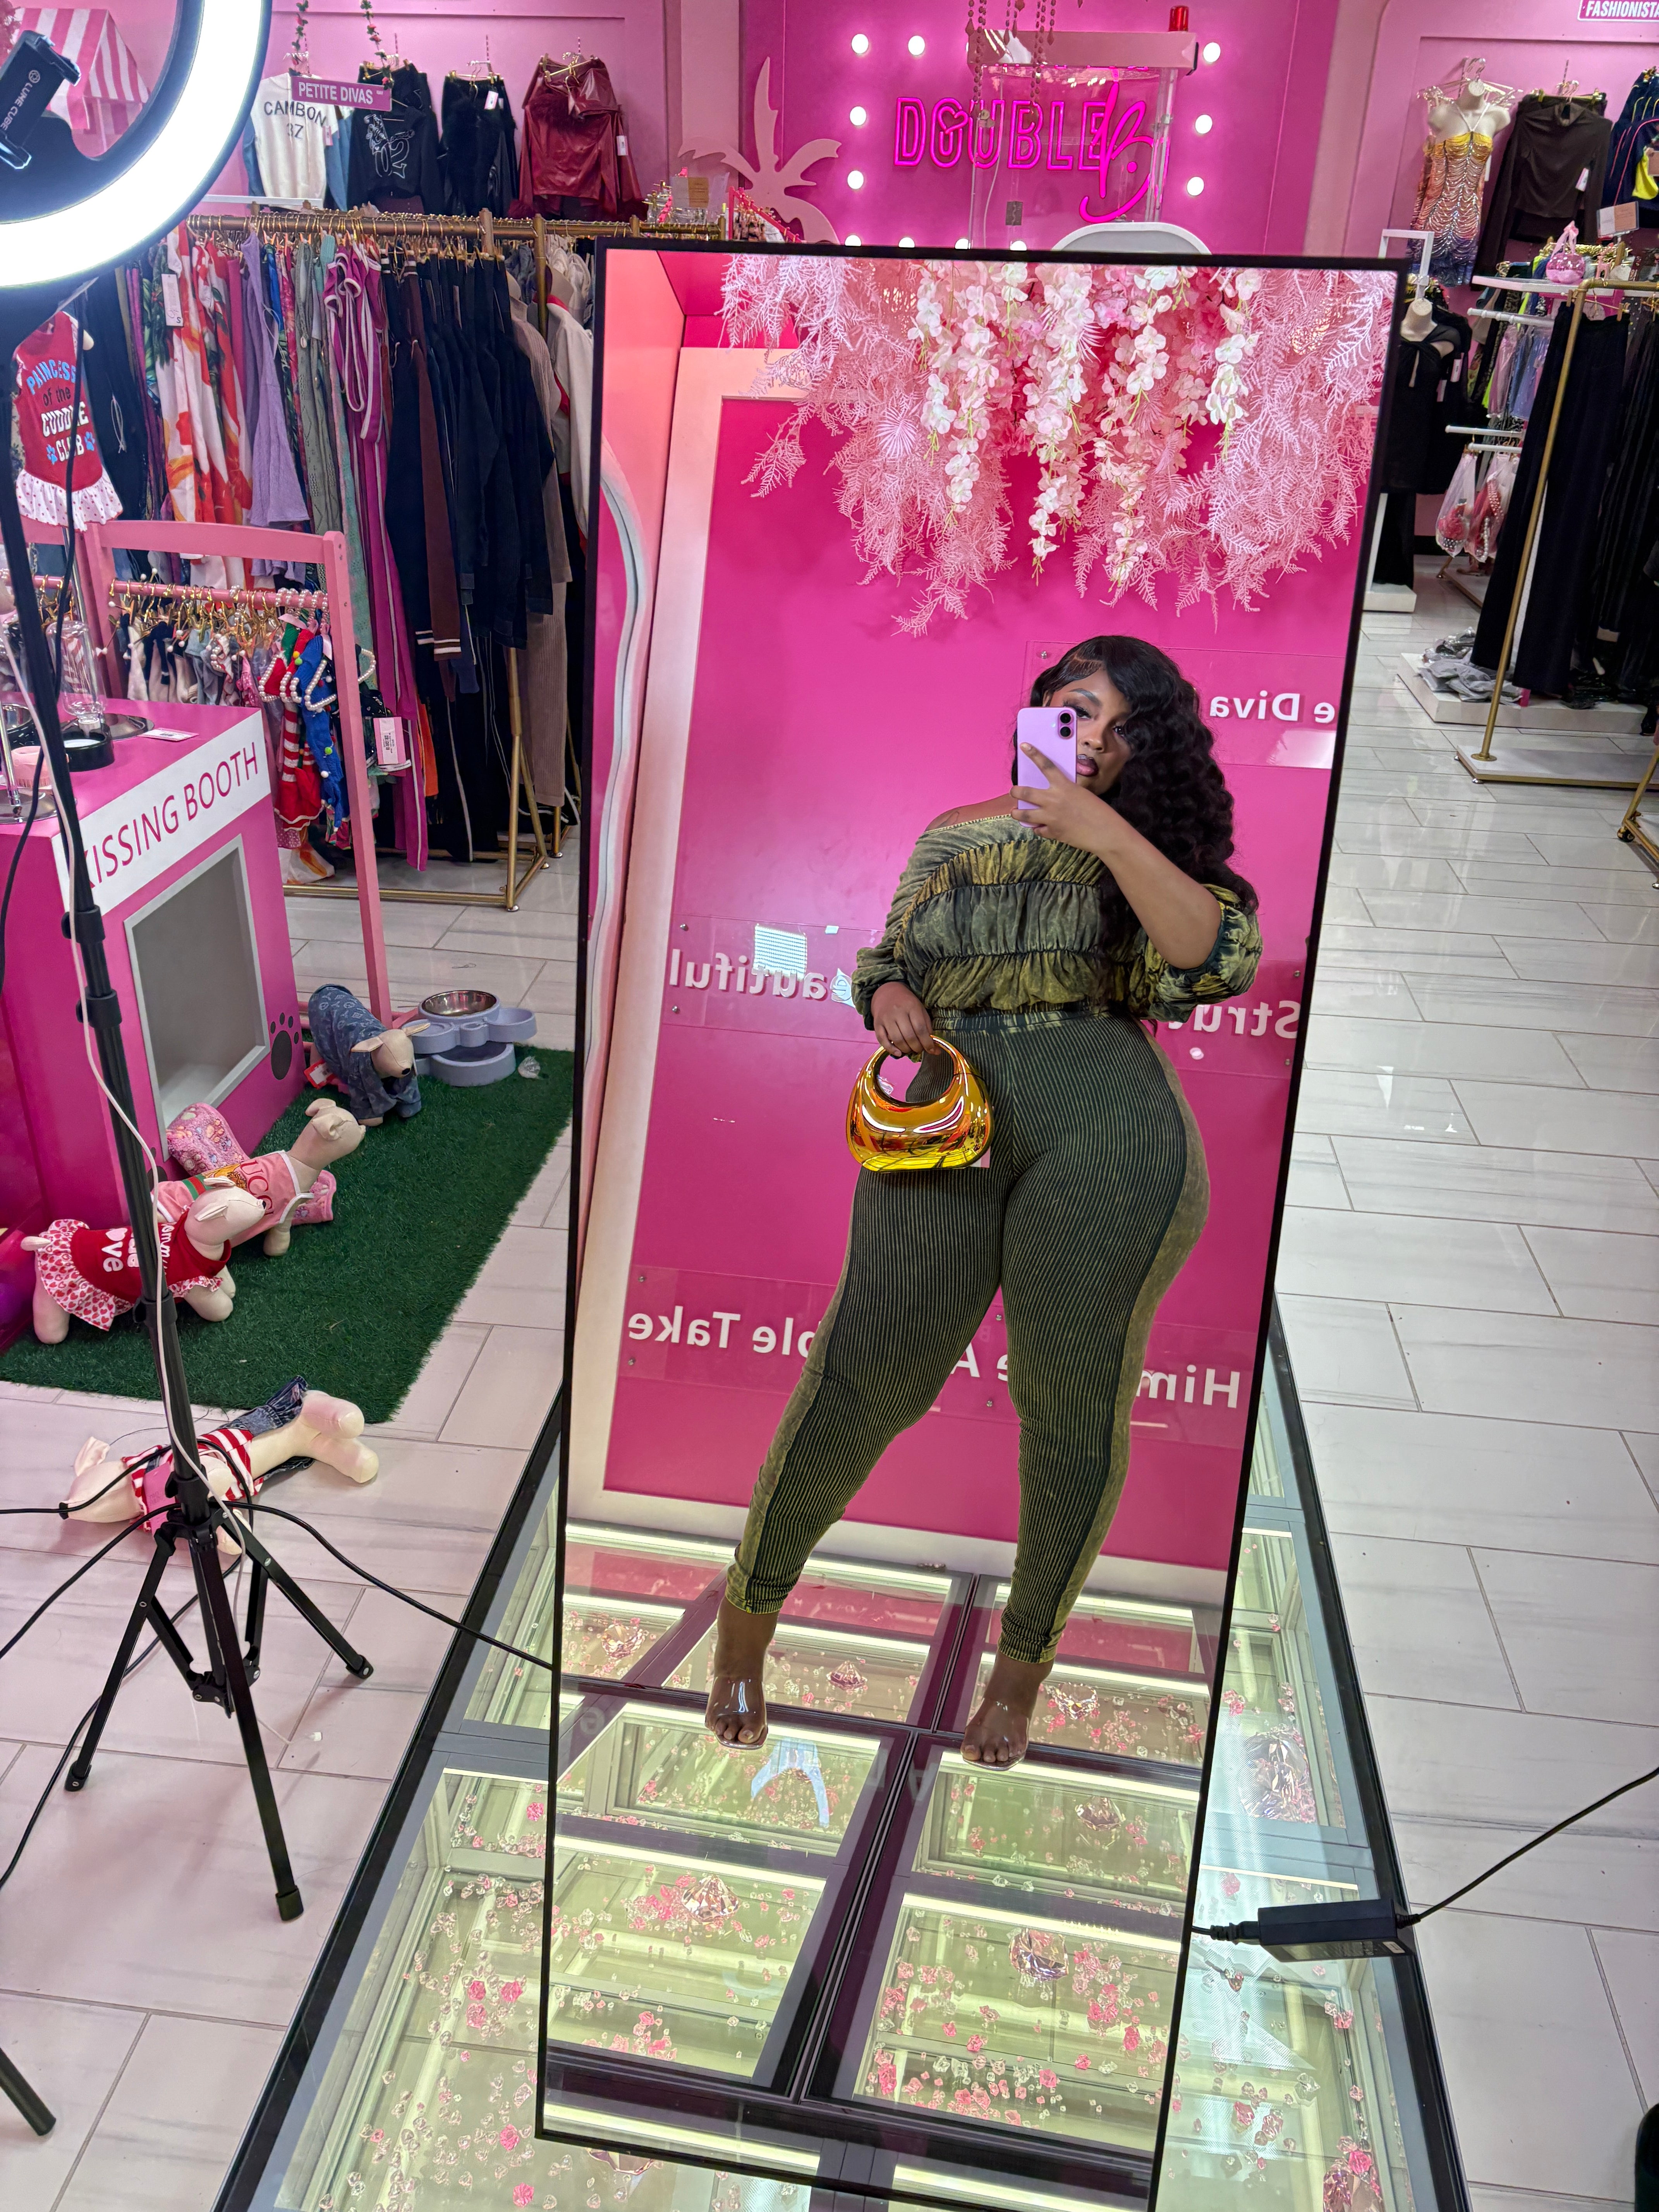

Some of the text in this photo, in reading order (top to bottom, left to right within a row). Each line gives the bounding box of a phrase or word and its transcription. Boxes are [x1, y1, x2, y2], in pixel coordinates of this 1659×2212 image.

[0, 82, 33, 131] LUME CUBE
[264, 100, 326, 127] CAMBON
[299, 82, 373, 105] PETITE DIVAS
[894, 97, 1107, 170] DOUBLE
[43, 388, 52, 406] of
[41, 401, 89, 437] CUDDE
[184, 742, 258, 821] BOOTH
[240, 1160, 274, 1216] UCCI
